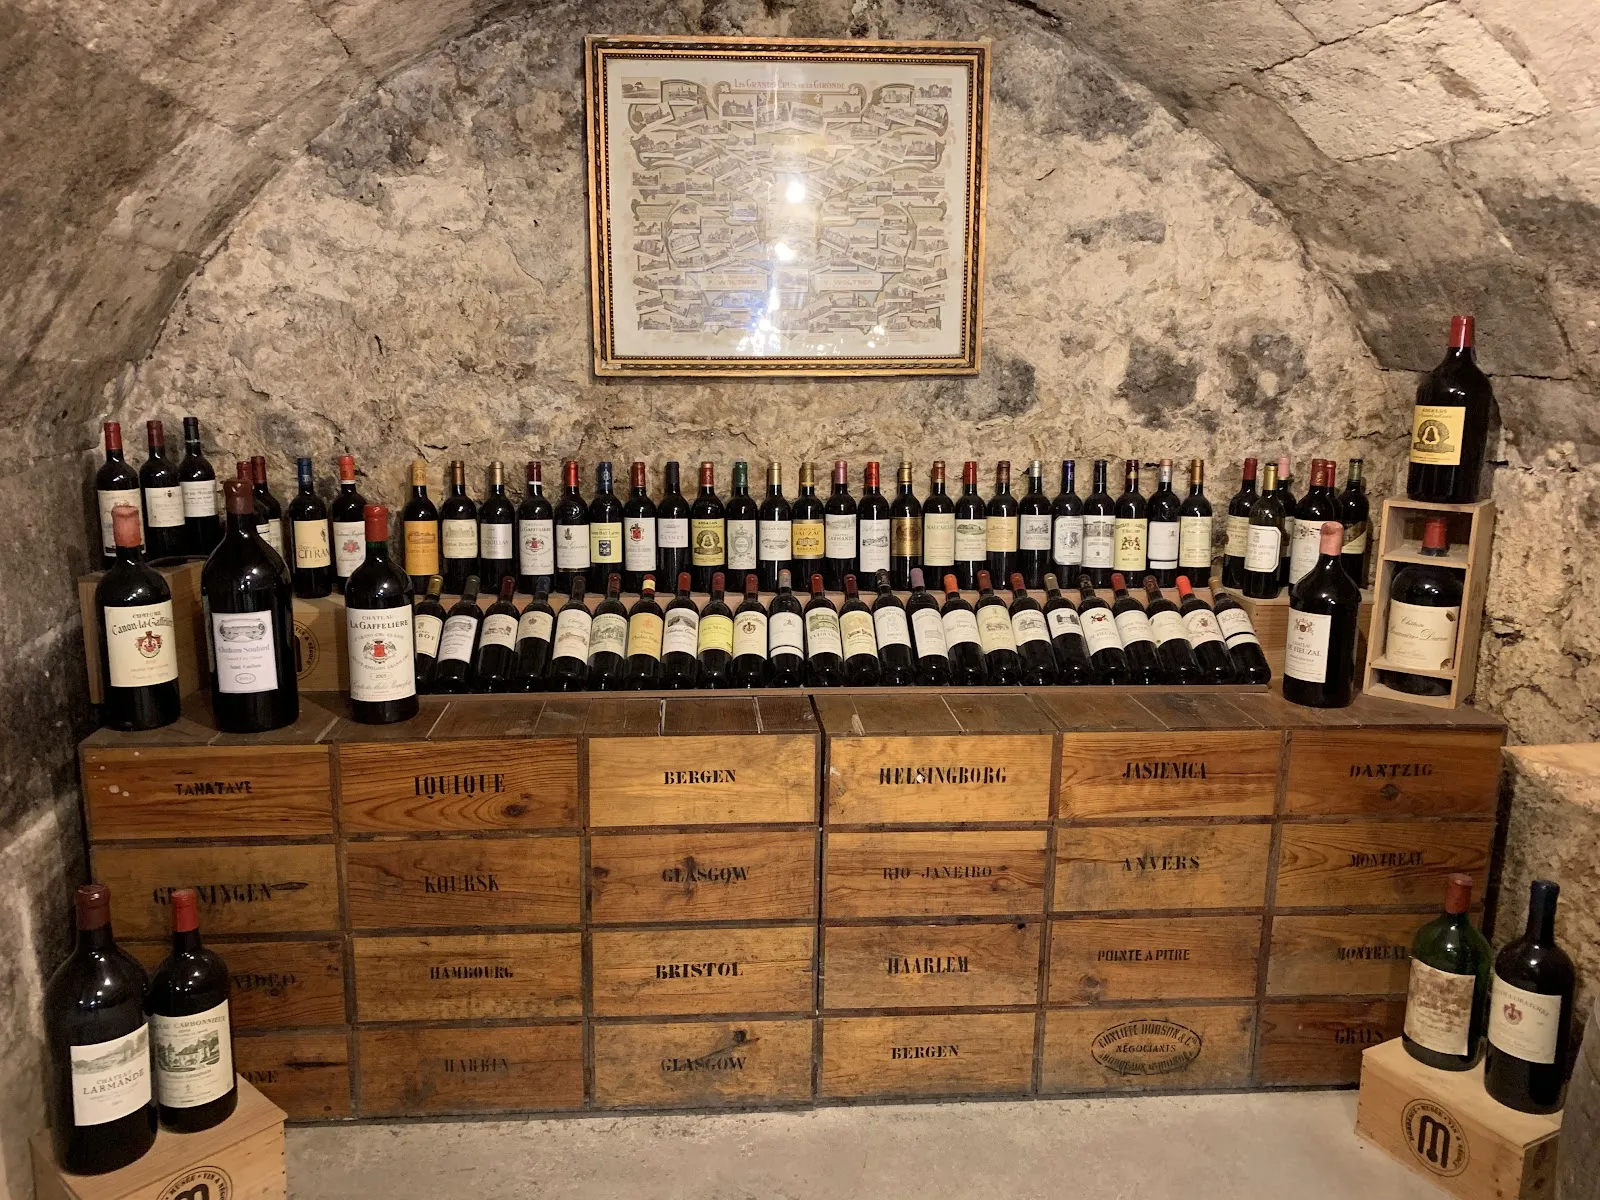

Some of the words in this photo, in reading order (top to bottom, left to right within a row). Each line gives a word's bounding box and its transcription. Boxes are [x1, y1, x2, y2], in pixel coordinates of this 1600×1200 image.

[814, 80, 845, 89] GIRONDE
[663, 769, 737, 785] BERGEN
[878, 766, 1008, 786] HELSINGBORG
[1349, 763, 1433, 778] DANTZIG
[414, 773, 506, 800] IQUIQUE
[1122, 855, 1200, 872] ANVERS
[1351, 851, 1424, 868] MONTREAL
[661, 865, 751, 886] GLASGOW
[882, 865, 911, 881] RIO
[920, 865, 993, 881] JANEIRO
[424, 873, 499, 895] KOURSK
[152, 884, 272, 906] GRNINGEN
[1097, 949, 1143, 962] POINTE
[1154, 948, 1191, 961] PITRE
[429, 964, 514, 982] HAMBOURG
[655, 961, 744, 980] BRISTOL
[887, 956, 969, 974] HAARLEM
[891, 1045, 960, 1060] BERGEN
[660, 1056, 747, 1073] GLASGOW
[83, 1068, 145, 1095] LARMANDE
